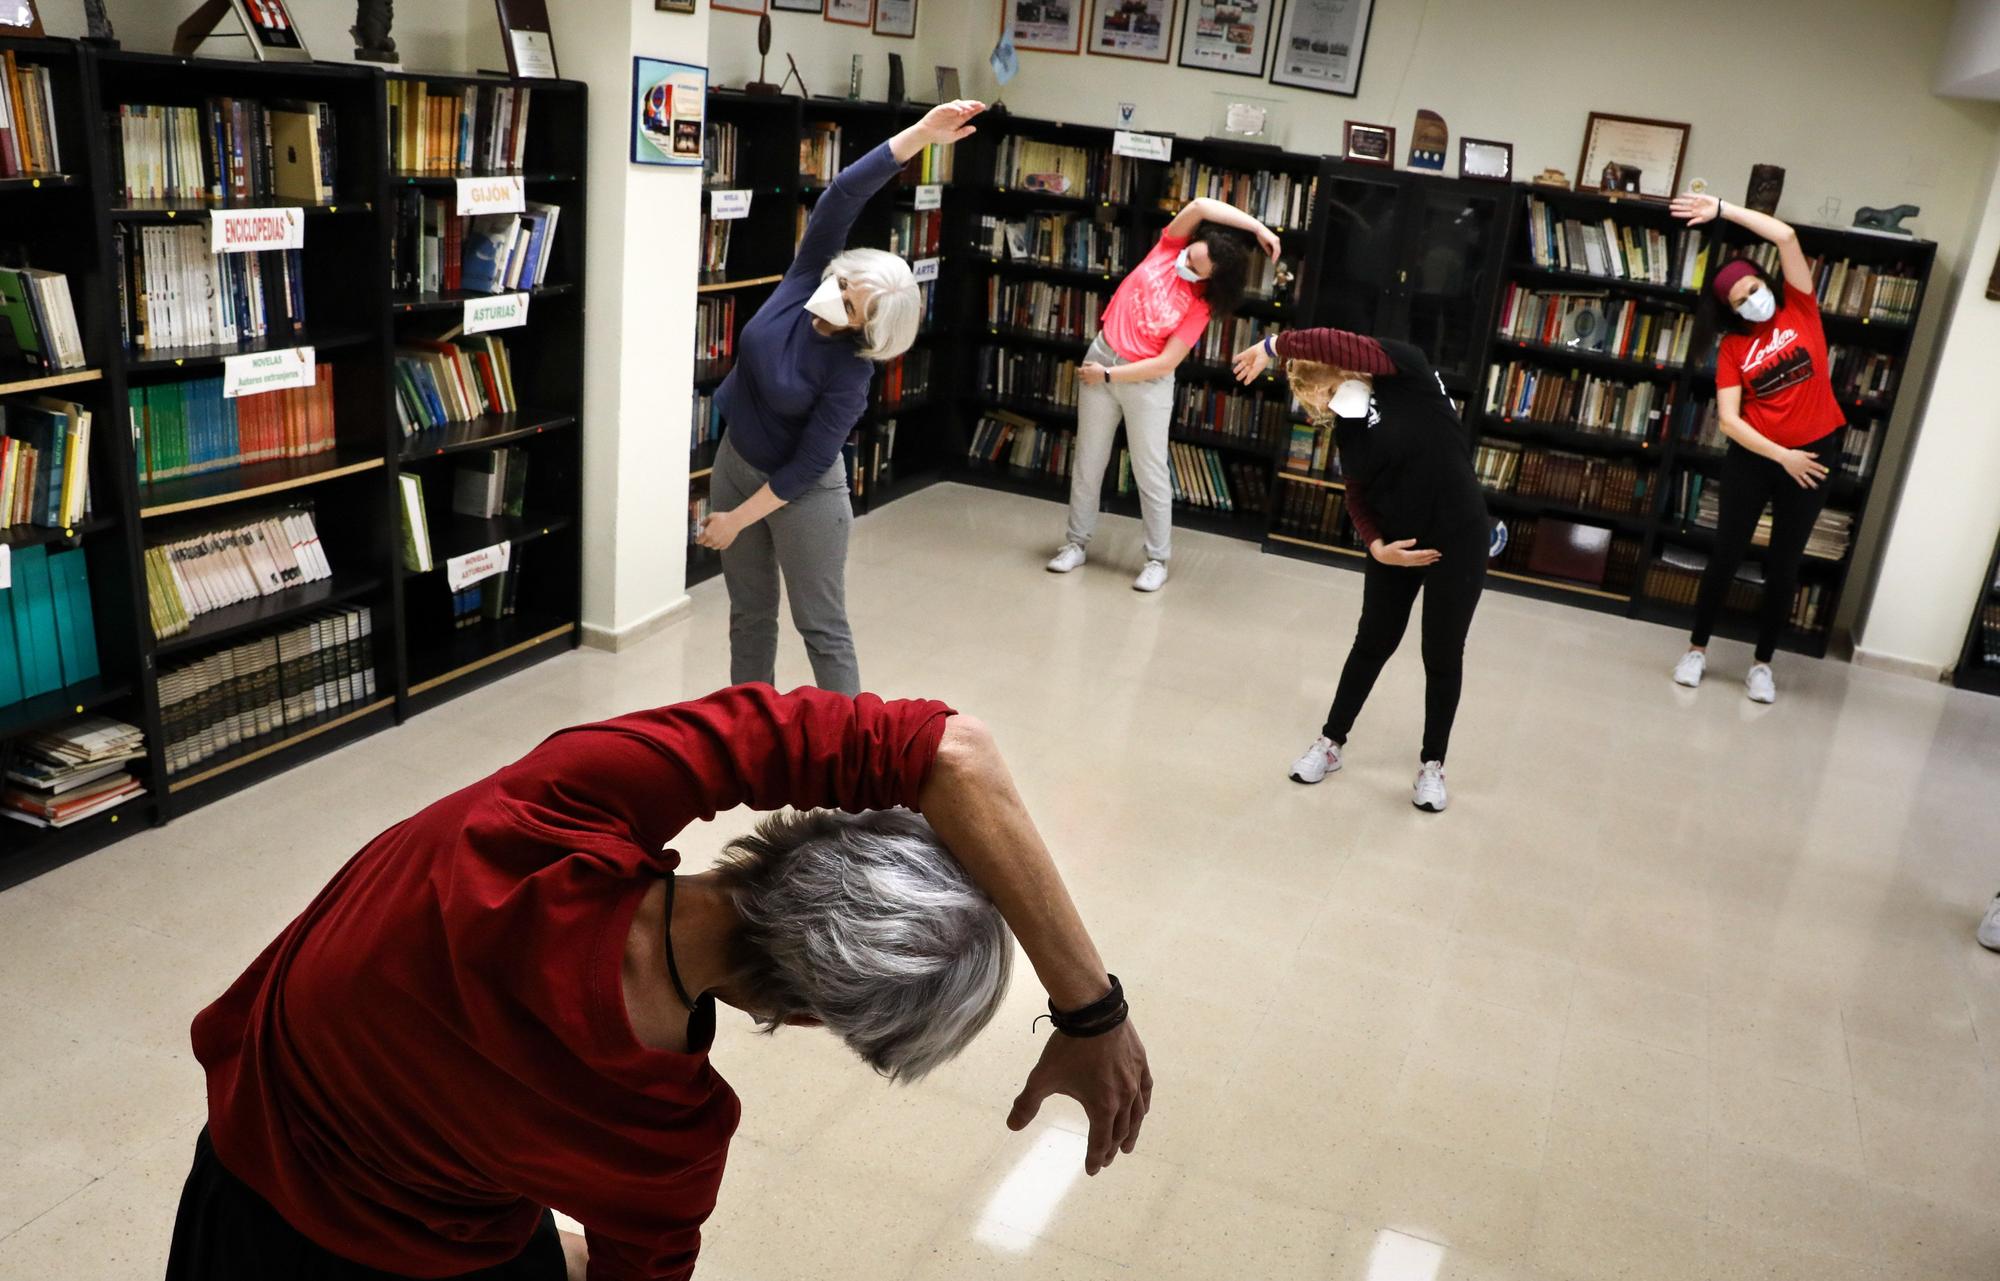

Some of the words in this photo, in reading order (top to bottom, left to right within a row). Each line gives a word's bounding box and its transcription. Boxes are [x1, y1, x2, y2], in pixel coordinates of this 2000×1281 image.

[471, 182, 511, 202] GIJÓN
[225, 216, 285, 243] ENCICLOPEDIAS
[916, 263, 935, 276] ARTE
[473, 304, 516, 321] ASTURIAS
[1741, 328, 1799, 373] London
[252, 355, 283, 368] NOVELAS
